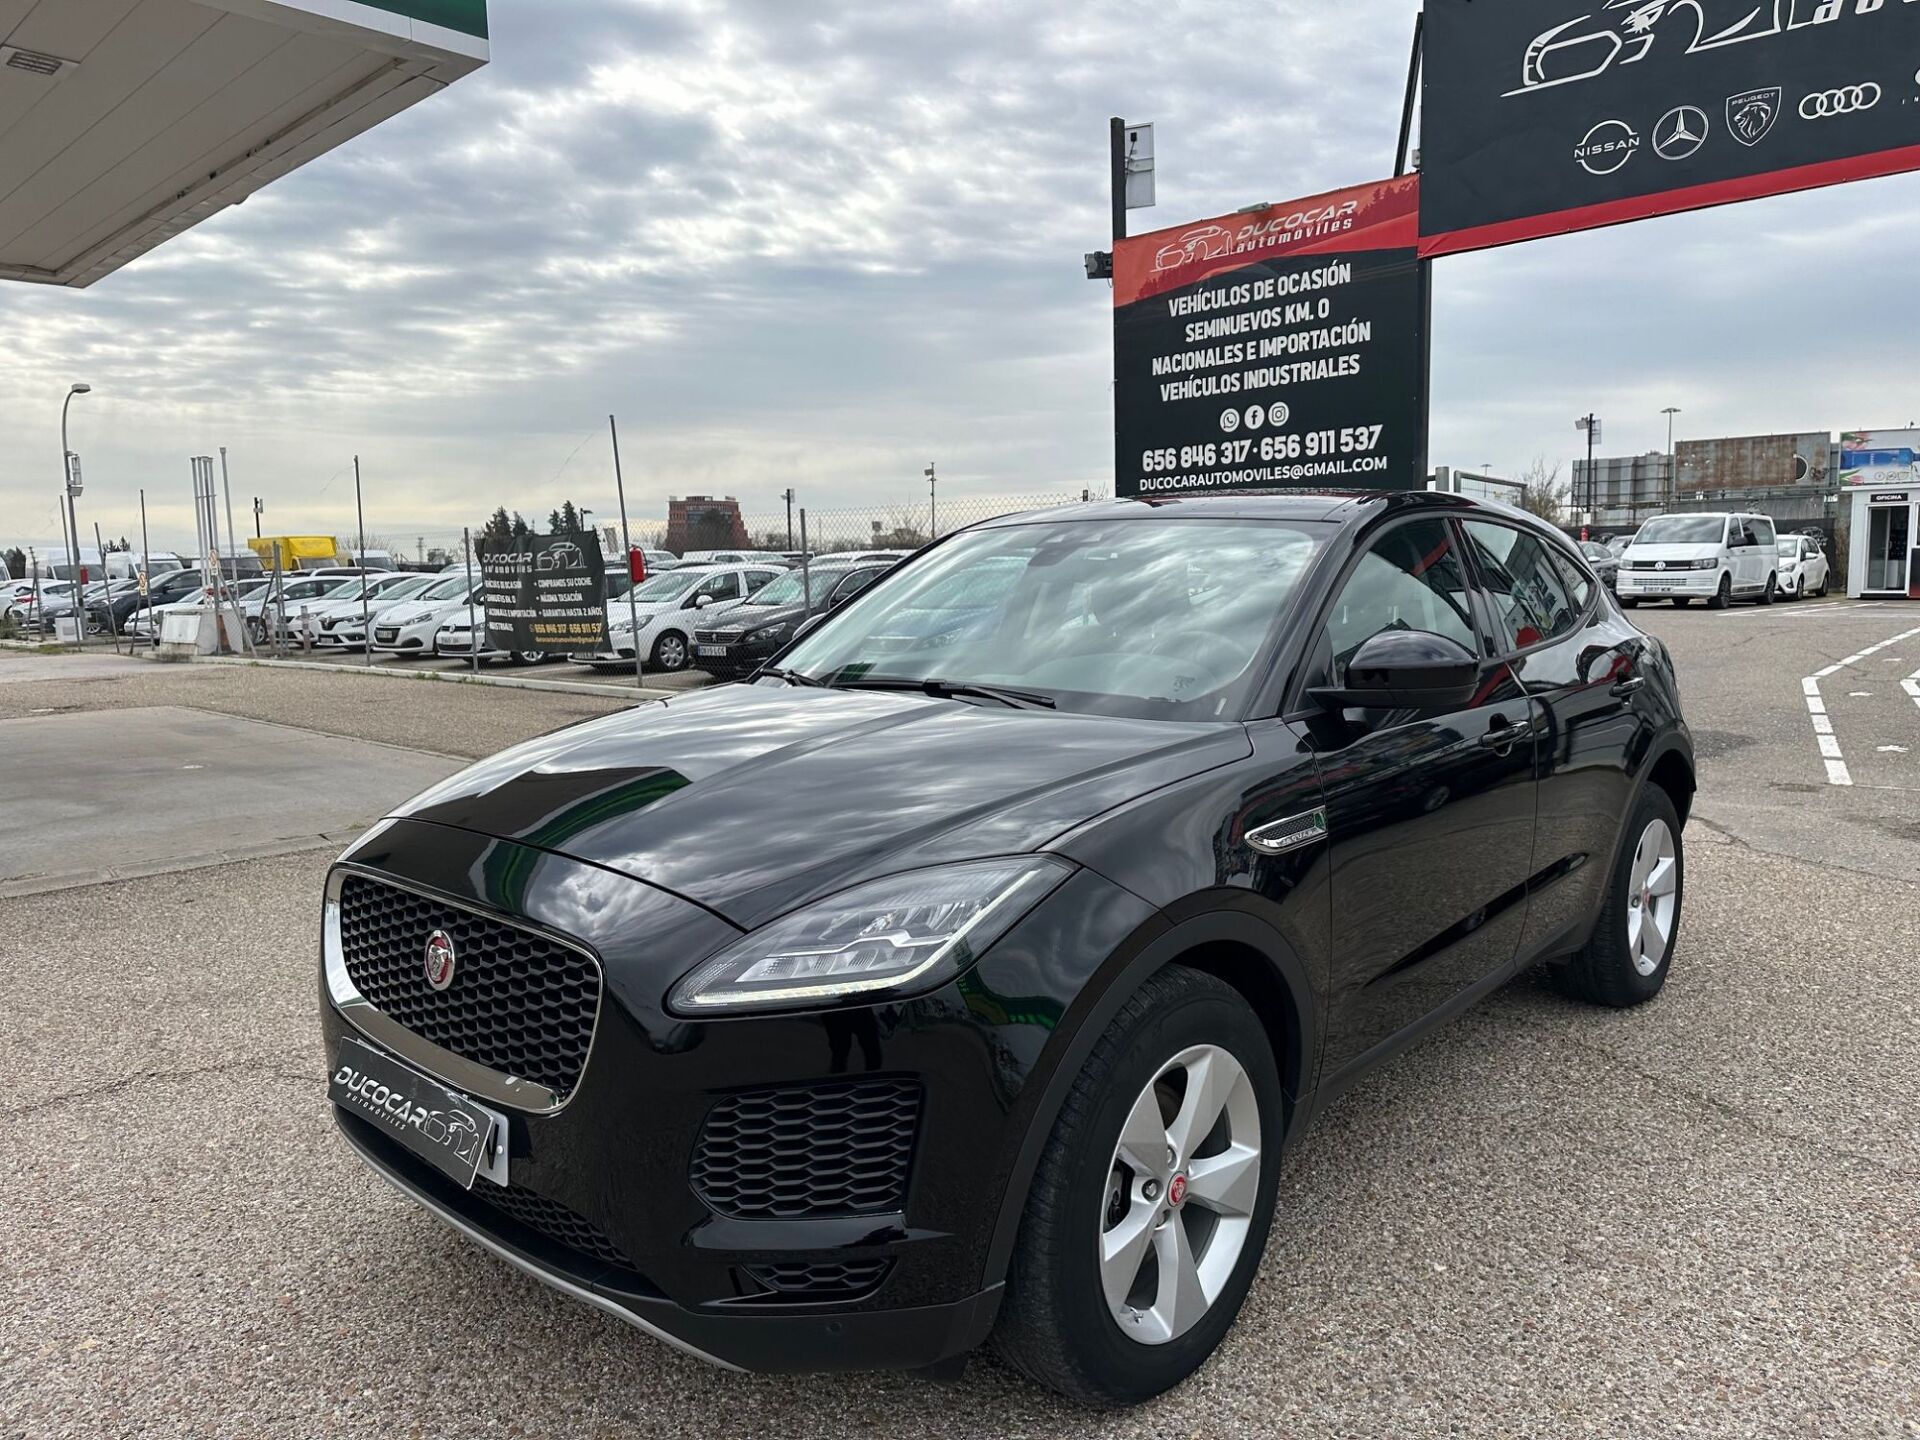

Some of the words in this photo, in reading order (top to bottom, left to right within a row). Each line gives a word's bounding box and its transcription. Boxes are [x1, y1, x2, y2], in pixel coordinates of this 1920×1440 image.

[1731, 91, 1776, 106] PEUGEOT
[1574, 137, 1640, 158] NISSAN
[1236, 200, 1358, 240] DUCOCAR
[1168, 283, 1250, 318] VEHÍCULOS
[1254, 279, 1275, 301] DE
[1278, 260, 1351, 296] OCASIÓN
[1185, 307, 1281, 343] SEMINUEVOS
[1285, 301, 1314, 324] KM.
[1152, 343, 1243, 376] NACIONALES
[1247, 341, 1257, 361] E
[1260, 318, 1371, 359] IMPORTACIÓN
[1160, 372, 1240, 402] VEHÍCULOS
[1244, 354, 1360, 390] INDUSTRIALES
[1142, 448, 1176, 472] 656
[1180, 443, 1216, 468] 846
[1305, 430, 1335, 456] 911
[1340, 424, 1383, 453] 537
[1140, 456, 1387, 491] DUCOCARAUTOMOVILES@GMAIL.COM
[574, 577, 593, 586] COCHE
[566, 608, 582, 617] HASTA
[583, 608, 588, 617] 2
[588, 606, 603, 616] AÑOS
[333, 1065, 428, 1129] DUCOCAR
[345, 1092, 406, 1131] AUTOMÓVILES
